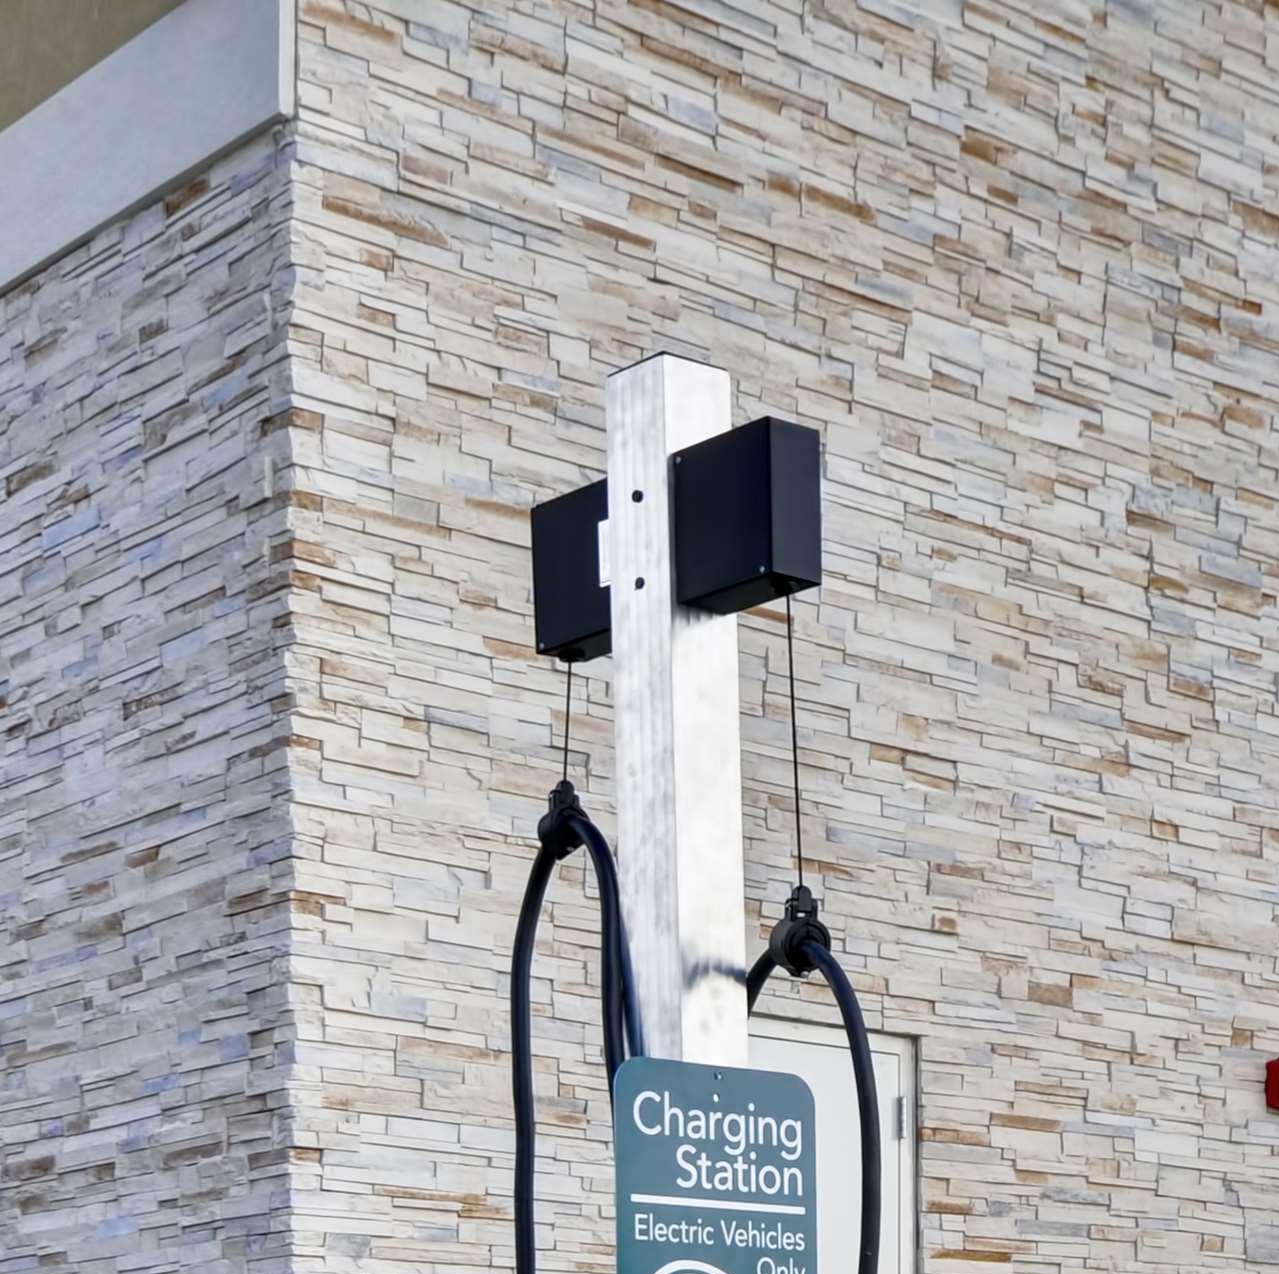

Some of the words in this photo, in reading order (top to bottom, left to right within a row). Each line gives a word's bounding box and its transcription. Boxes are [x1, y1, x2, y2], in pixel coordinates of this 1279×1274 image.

[632, 1090, 803, 1161] Charging
[676, 1145, 803, 1196] Station
[635, 1214, 714, 1245] Electric
[720, 1220, 805, 1251] Vehicles
